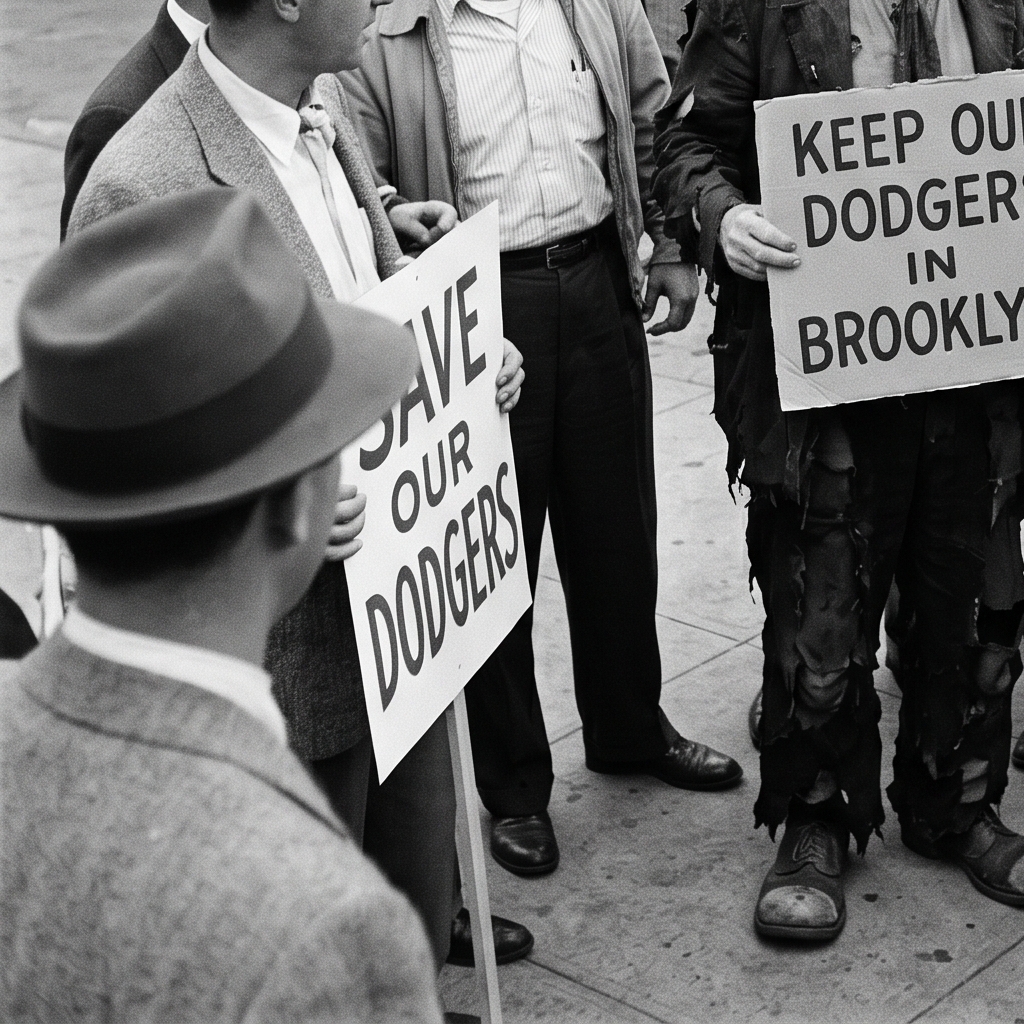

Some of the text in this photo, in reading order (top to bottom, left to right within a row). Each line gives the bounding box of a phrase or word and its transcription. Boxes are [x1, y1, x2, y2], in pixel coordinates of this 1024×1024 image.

[792, 108, 925, 178] KEEP
[906, 246, 957, 286] IN
[391, 420, 474, 533] OUR
[365, 461, 519, 712] DODGERS
